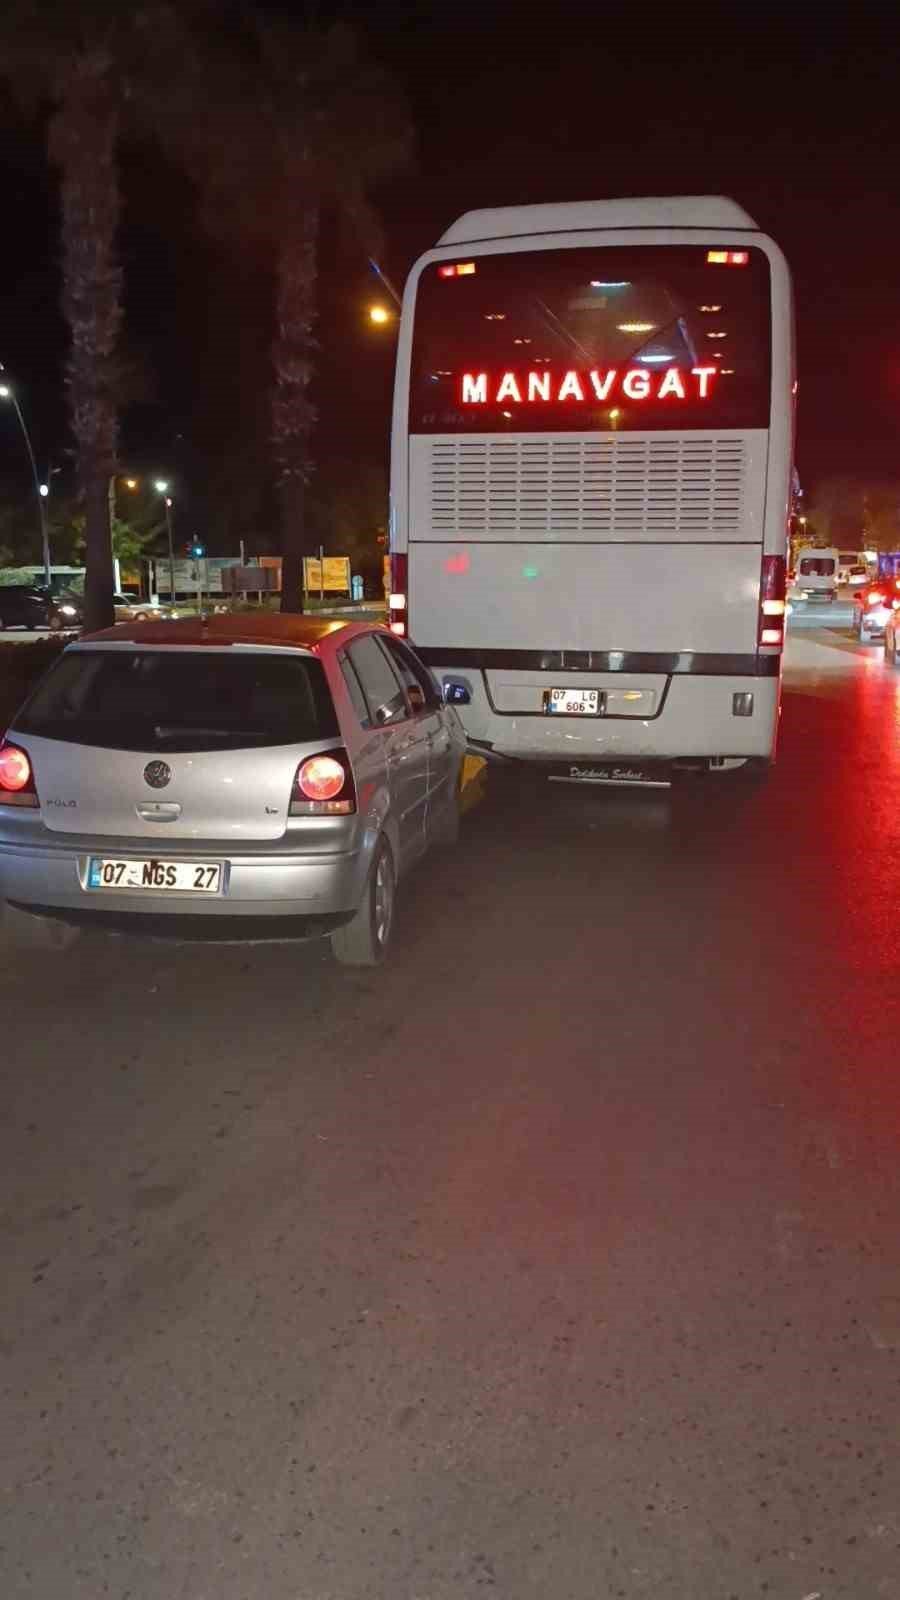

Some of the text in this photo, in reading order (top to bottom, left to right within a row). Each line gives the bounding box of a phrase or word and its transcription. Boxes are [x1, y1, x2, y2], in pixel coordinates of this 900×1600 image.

[462, 367, 717, 403] MANAVGAT
[553, 690, 596, 702] 07 LG
[103, 863, 218, 888] 07 NGS 27
